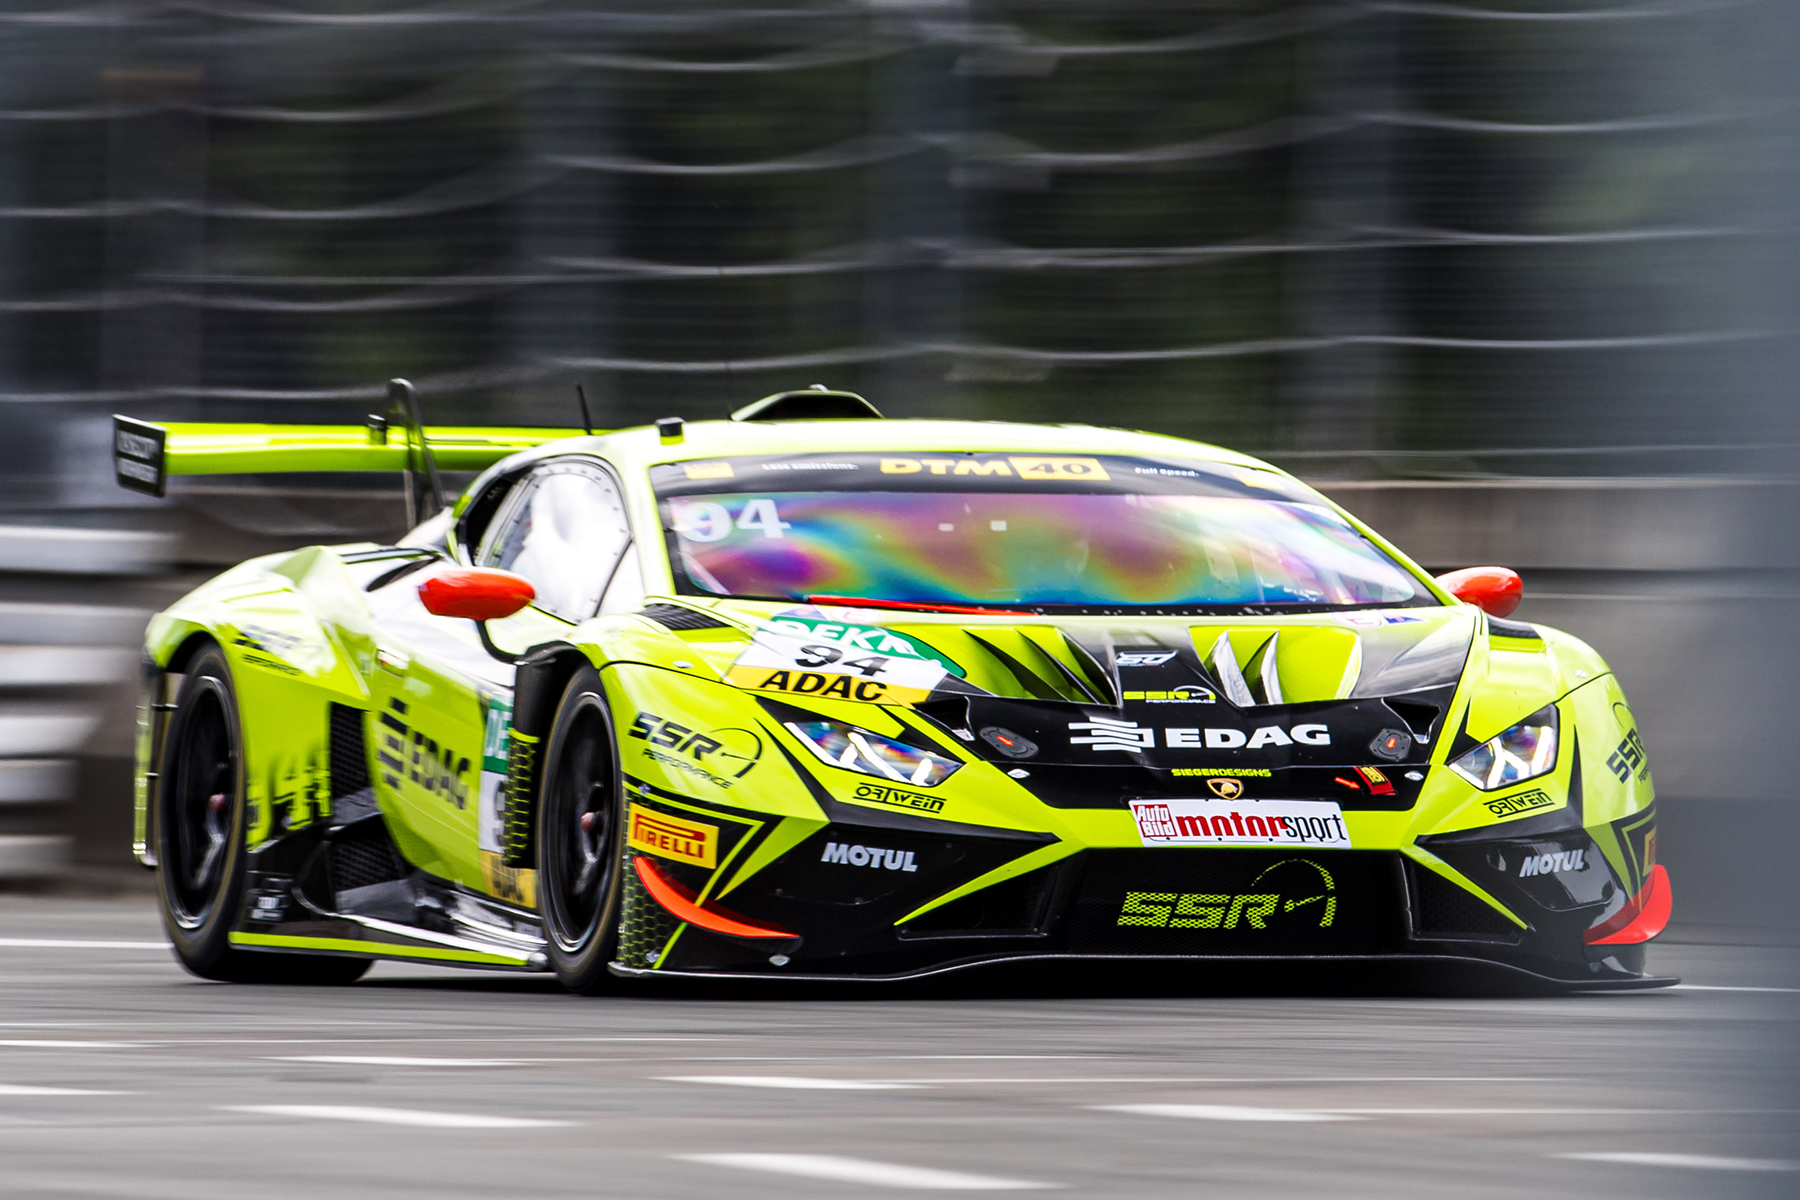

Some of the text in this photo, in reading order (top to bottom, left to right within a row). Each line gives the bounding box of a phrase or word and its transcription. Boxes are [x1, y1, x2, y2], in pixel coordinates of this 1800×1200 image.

[879, 458, 1093, 476] DTM 40
[677, 498, 792, 543] 94
[795, 644, 890, 677] 94
[759, 670, 888, 702] ADAC
[1123, 690, 1190, 700] SSR
[627, 711, 723, 761] SSR
[1165, 723, 1331, 749] EDAG
[411, 730, 470, 810] EDAG
[1137, 805, 1169, 822] Auto
[1140, 820, 1176, 837] Bild
[634, 812, 706, 859] PIRELLI
[821, 841, 919, 873] MOTUL
[1519, 848, 1585, 878] MOTUL
[1117, 891, 1281, 929] SSR
